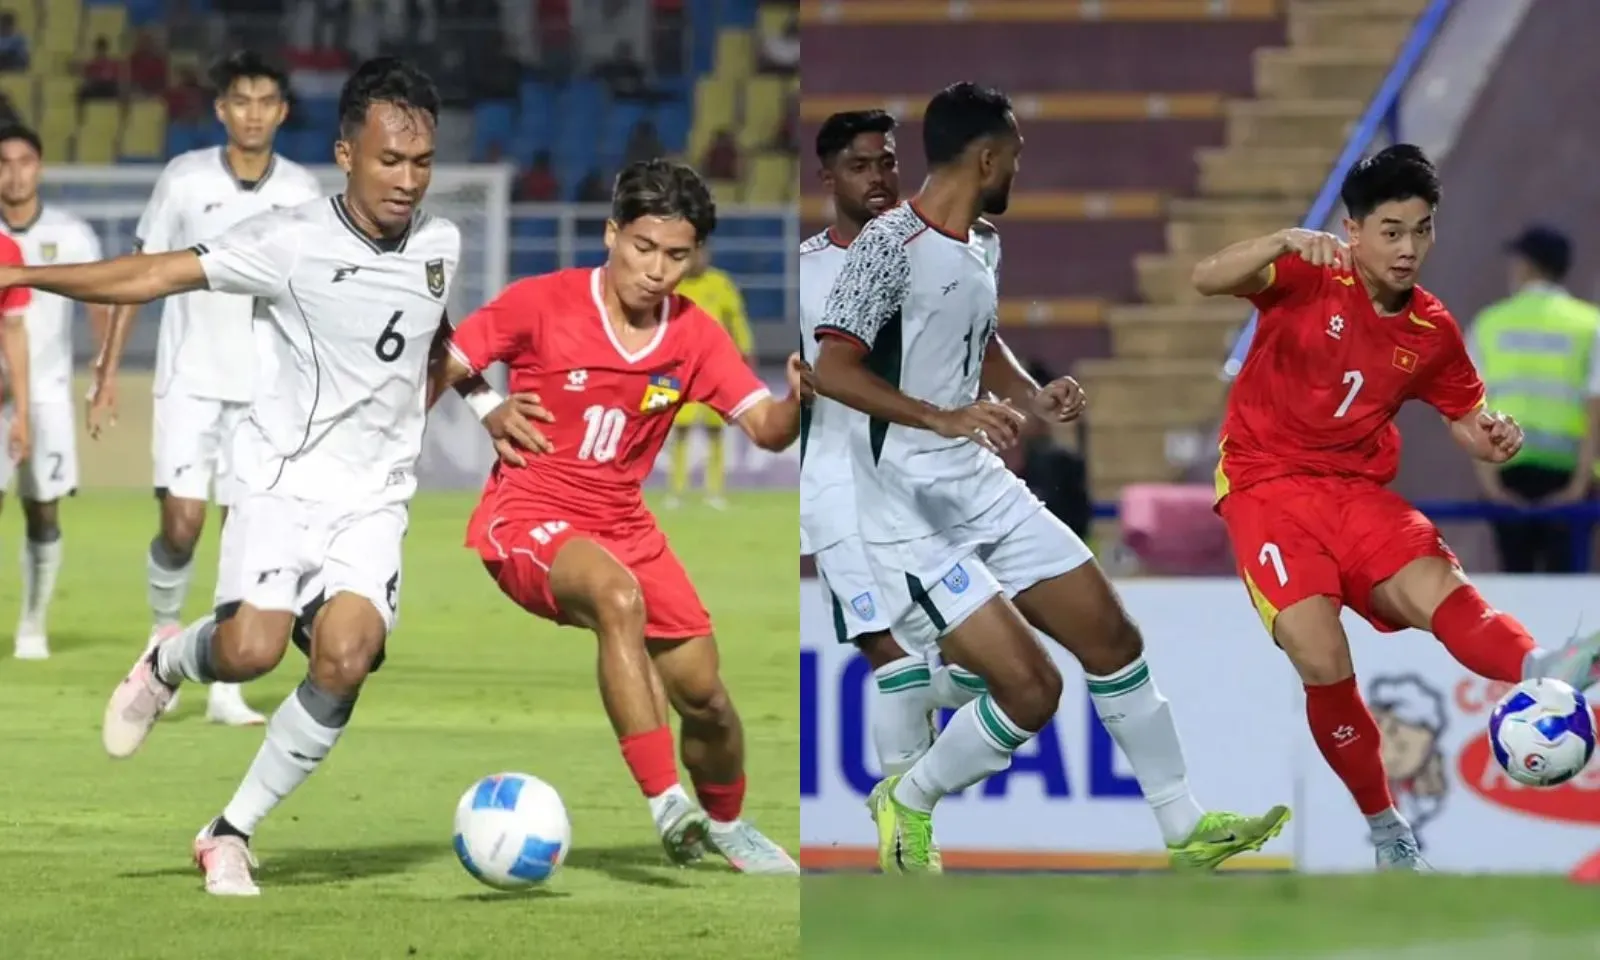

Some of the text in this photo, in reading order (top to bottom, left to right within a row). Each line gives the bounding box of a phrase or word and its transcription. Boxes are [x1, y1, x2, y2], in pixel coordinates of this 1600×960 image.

[375, 310, 405, 363] 6
[1333, 369, 1364, 418] 7
[577, 405, 627, 463] 10
[46, 450, 65, 482] 2
[1258, 541, 1289, 588] 7
